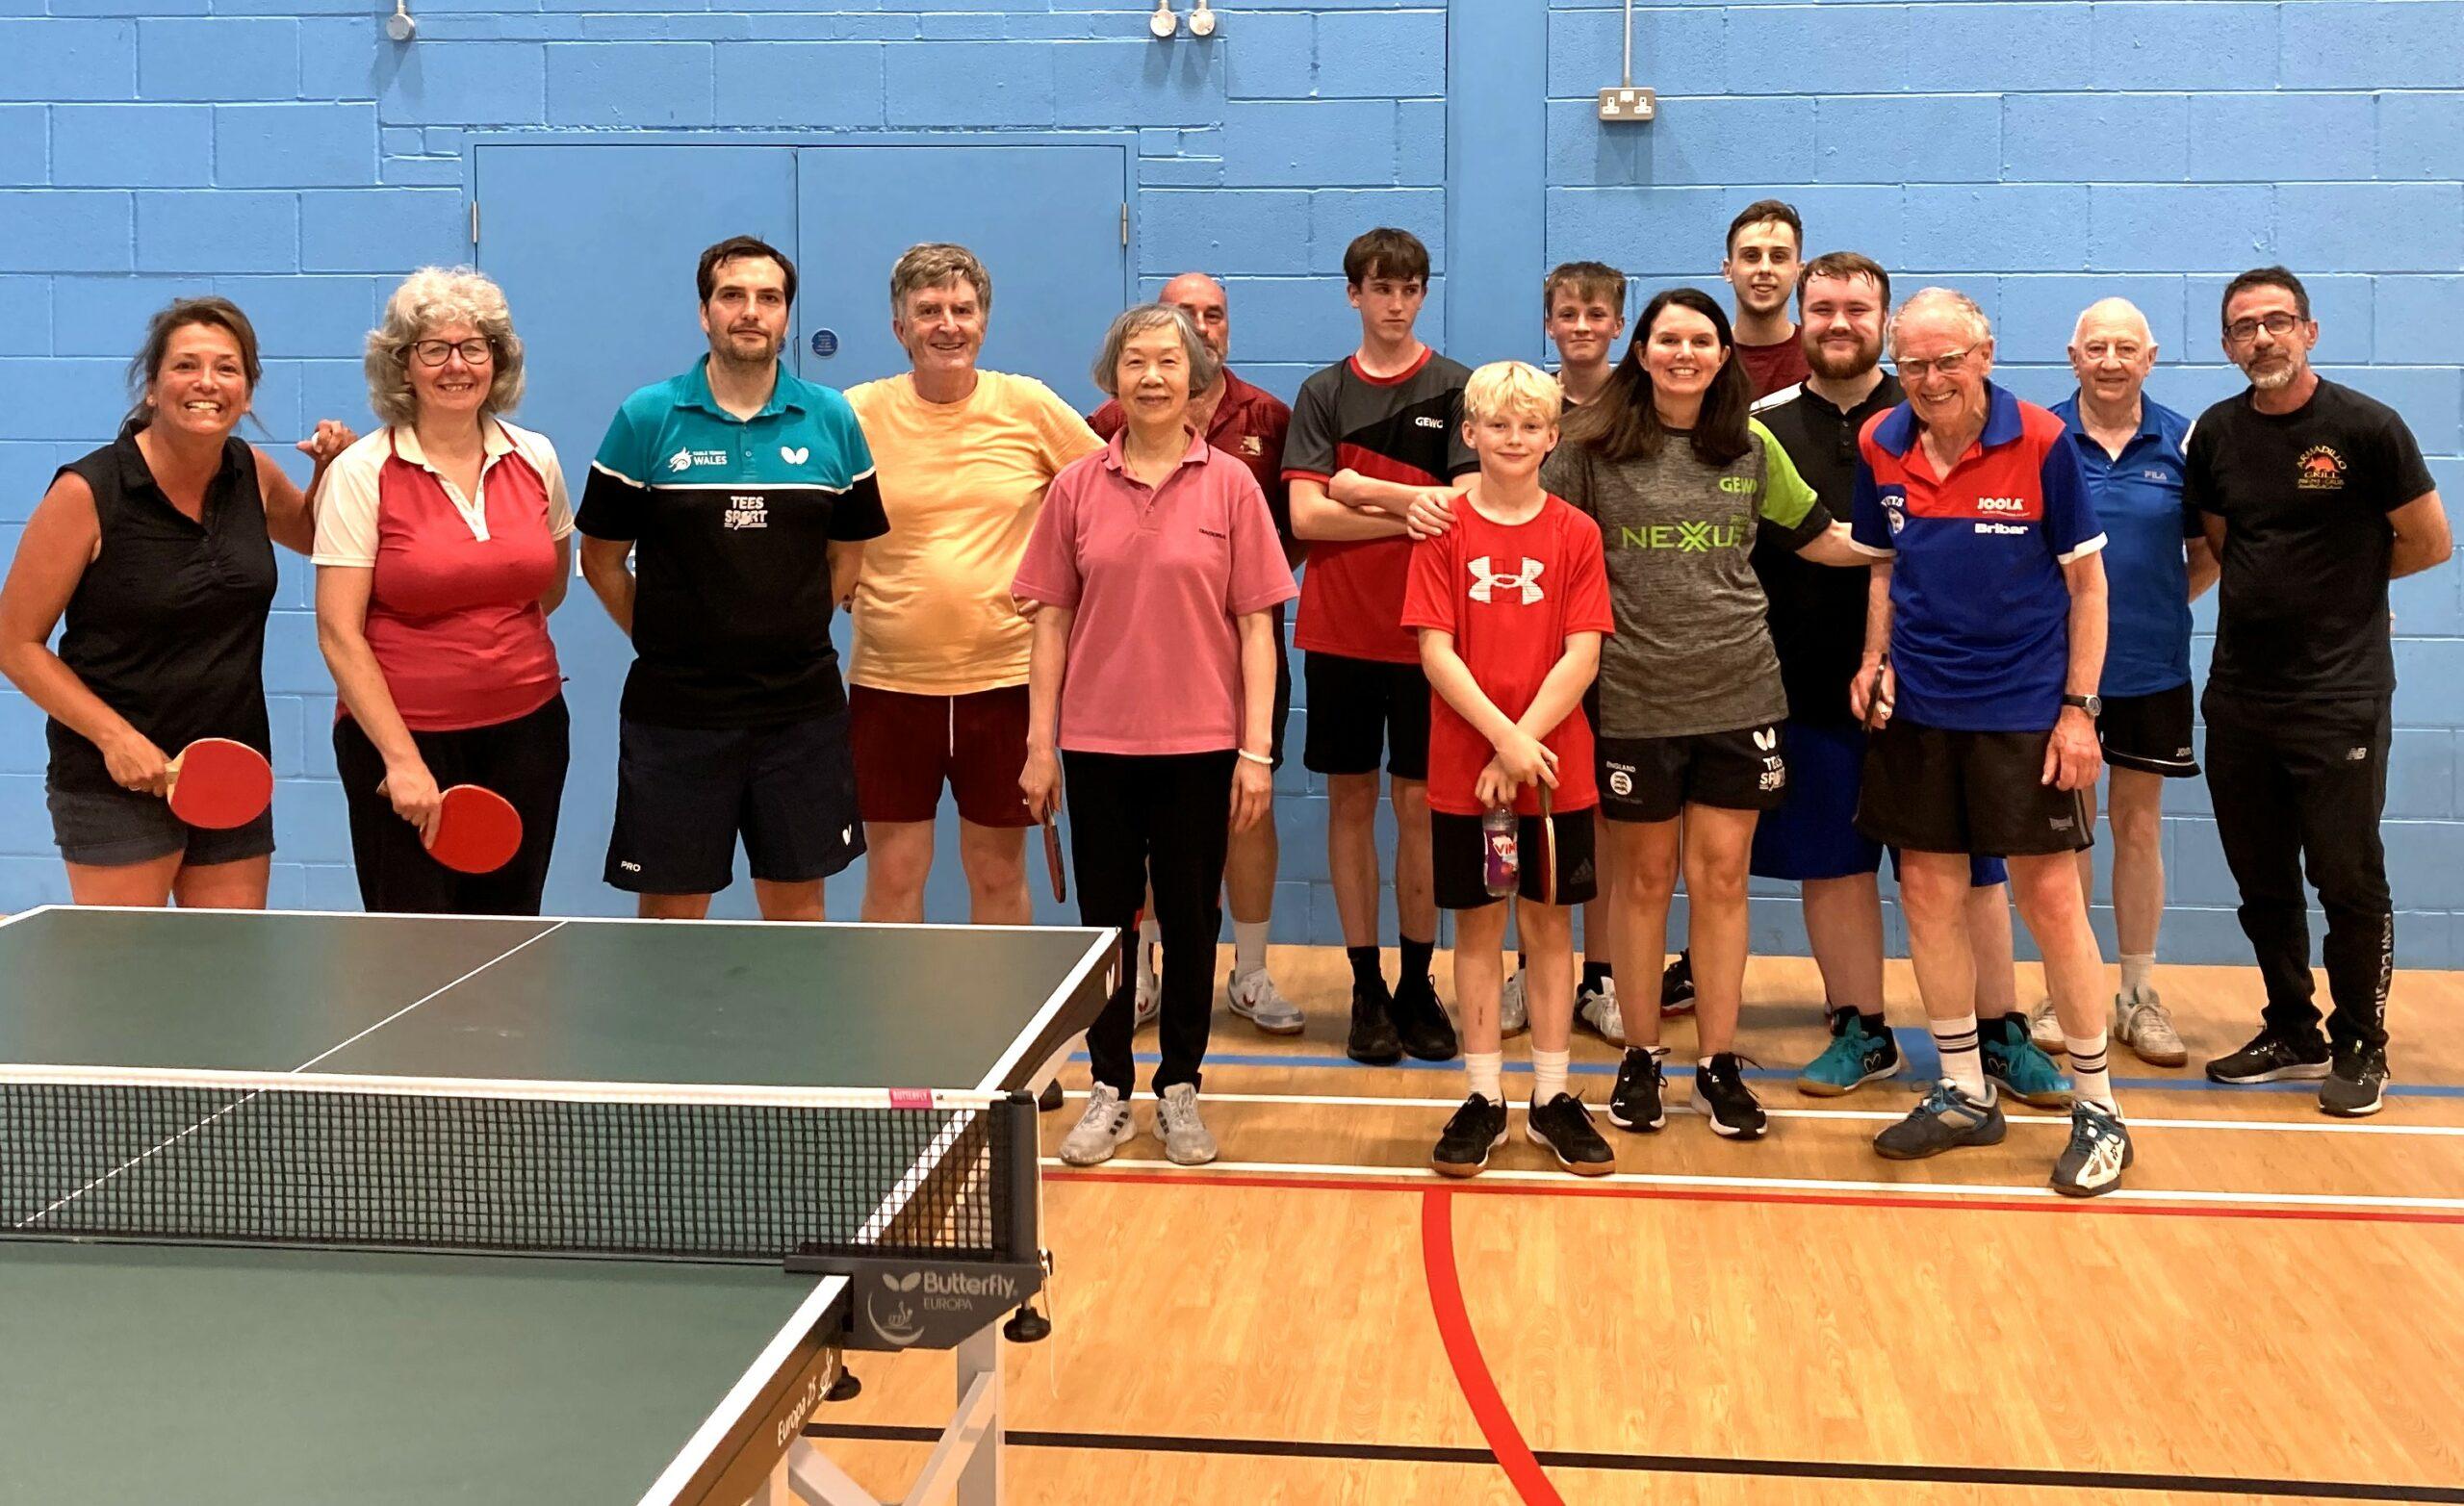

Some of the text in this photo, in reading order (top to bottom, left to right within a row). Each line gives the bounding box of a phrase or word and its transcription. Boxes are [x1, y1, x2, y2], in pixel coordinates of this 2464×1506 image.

[693, 455, 728, 466] WALES
[2143, 470, 2168, 480] FILA
[731, 496, 764, 510] TEES
[1977, 497, 2023, 510] JOOLA
[724, 510, 768, 525] SPORT
[1974, 523, 2029, 535] Bribar
[621, 860, 642, 873] PRO
[923, 1270, 1016, 1299] Butterfly
[923, 1298, 973, 1312] EUROPA
[777, 1375, 817, 1448] Europa 25
